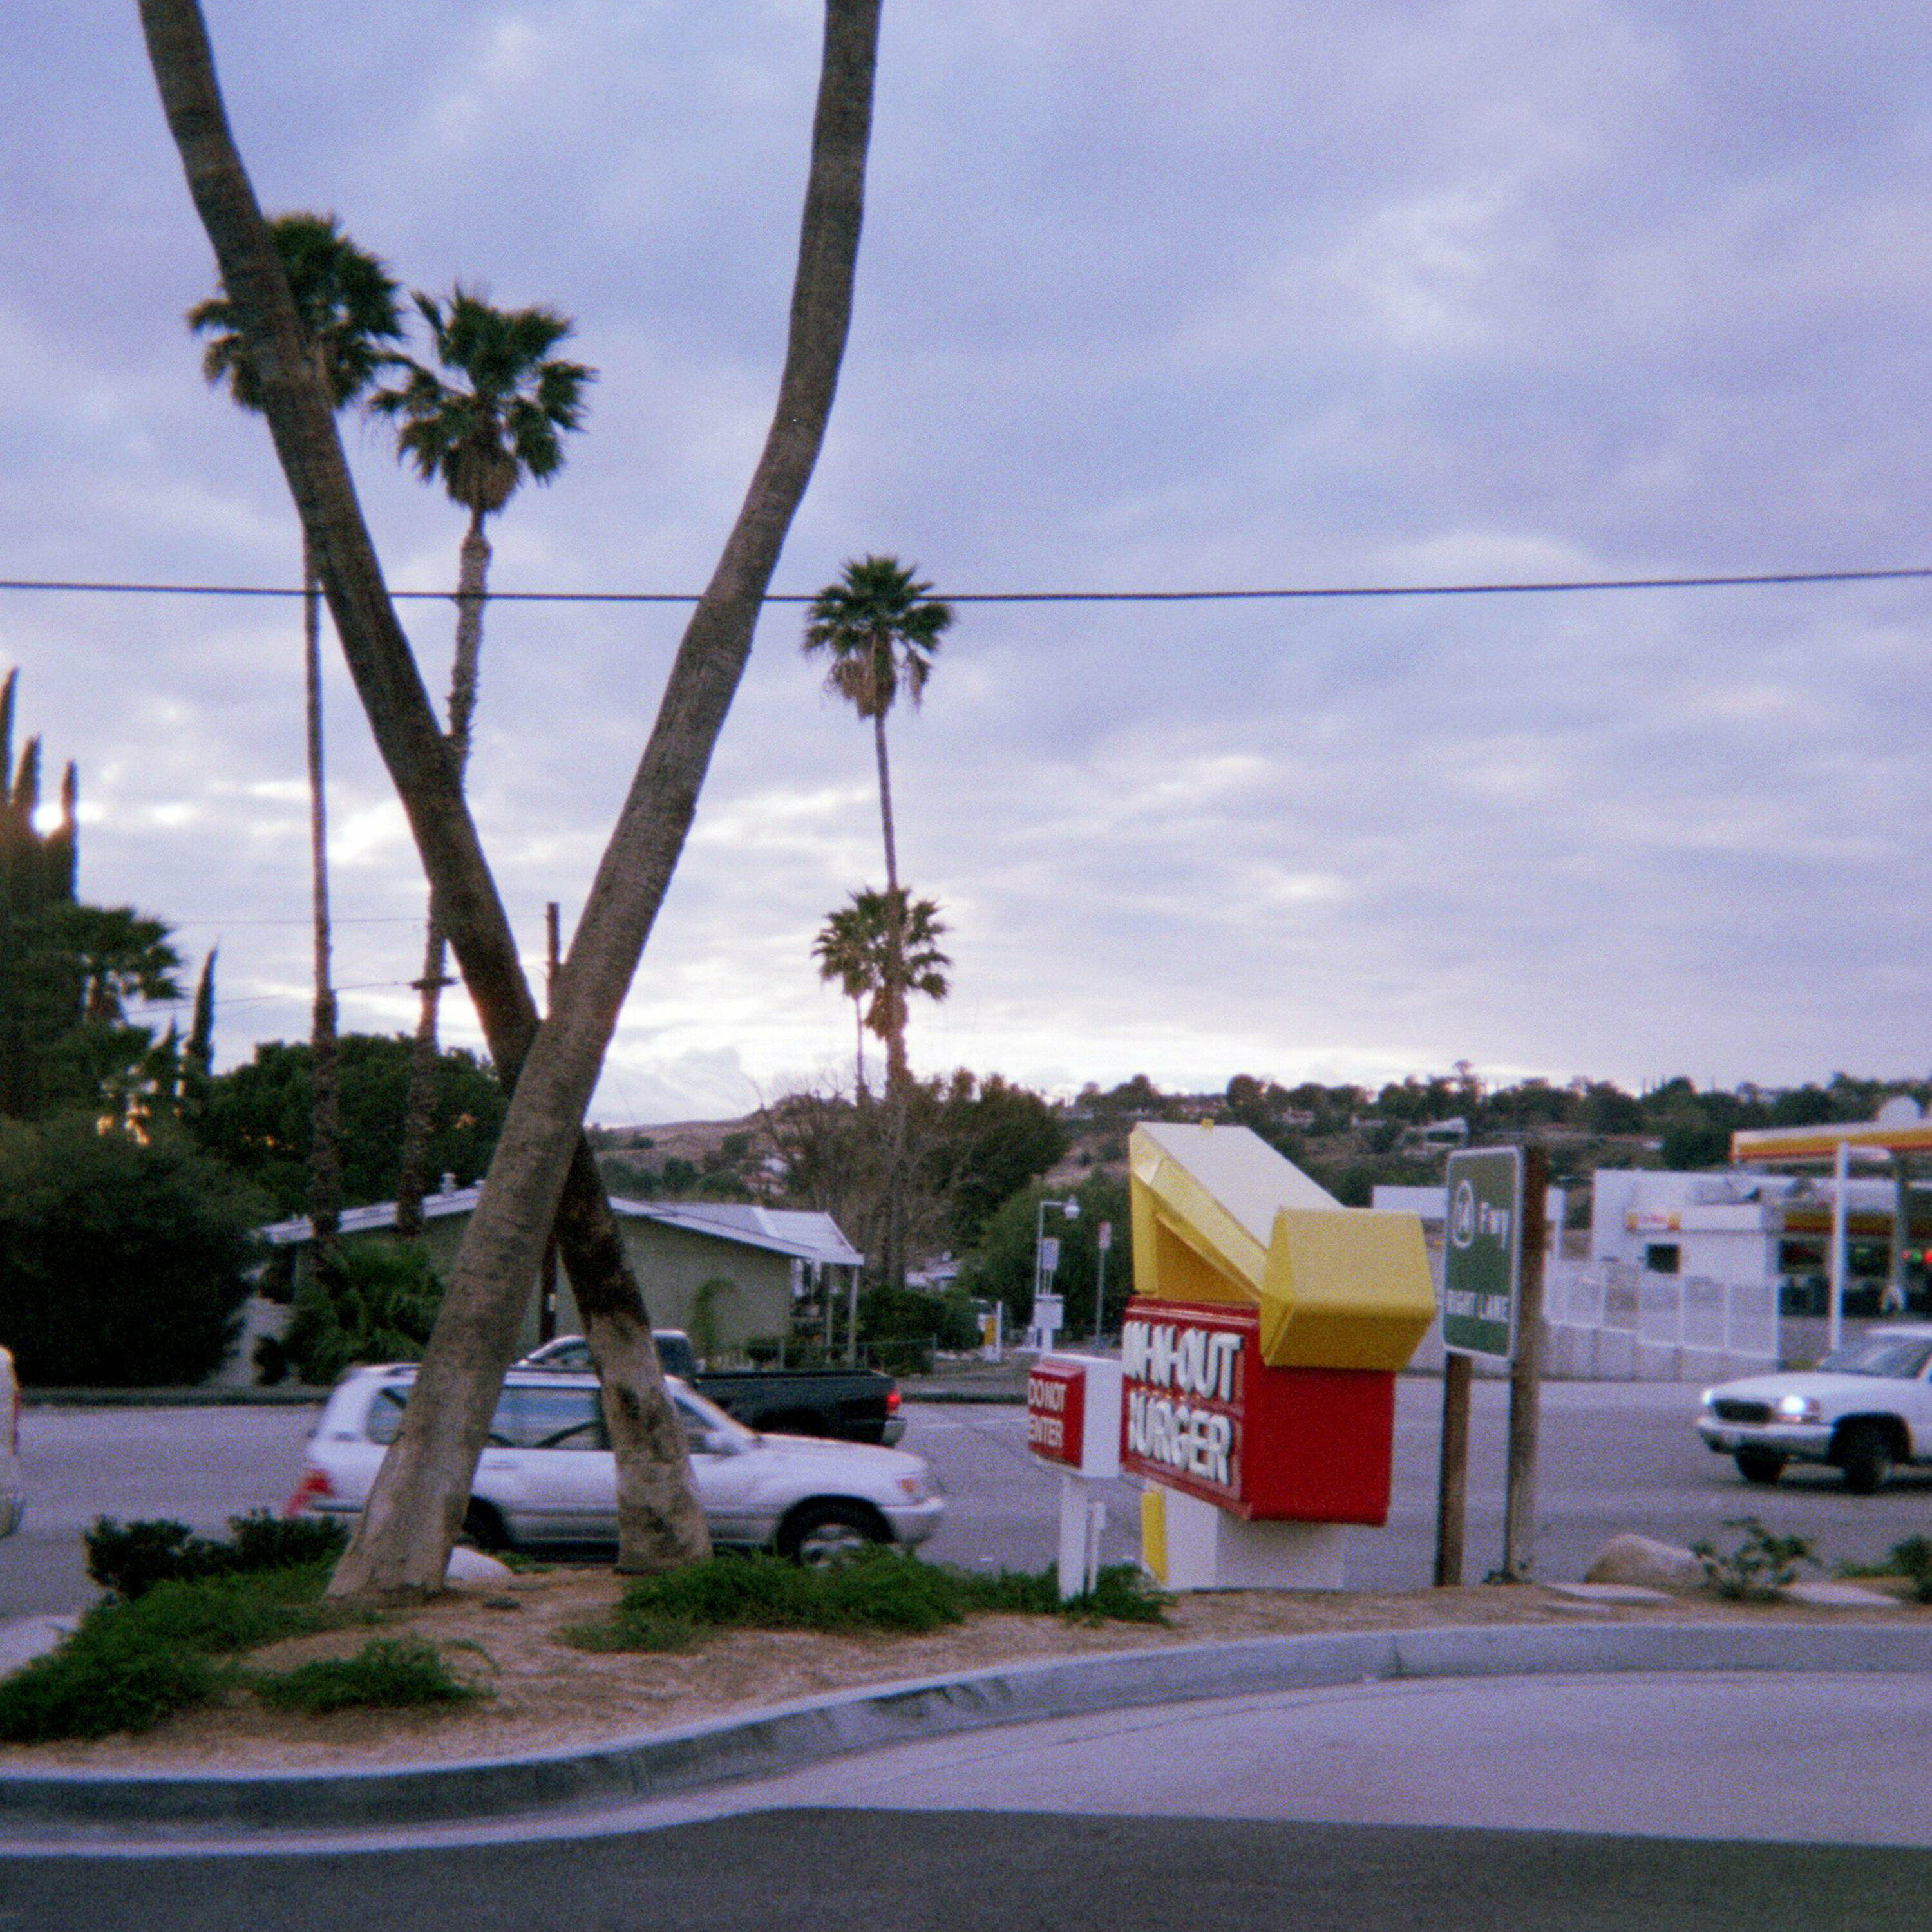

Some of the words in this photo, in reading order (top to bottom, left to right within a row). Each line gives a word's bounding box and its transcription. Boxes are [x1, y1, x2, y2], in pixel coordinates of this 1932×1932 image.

[1444, 1289, 1475, 1316] RIGHT
[1479, 1293, 1509, 1323] LANE
[1123, 1321, 1243, 1401] IN-N-OUT
[1028, 1378, 1044, 1408] DO
[1045, 1380, 1066, 1412] NOT
[1028, 1414, 1063, 1449] ENTER
